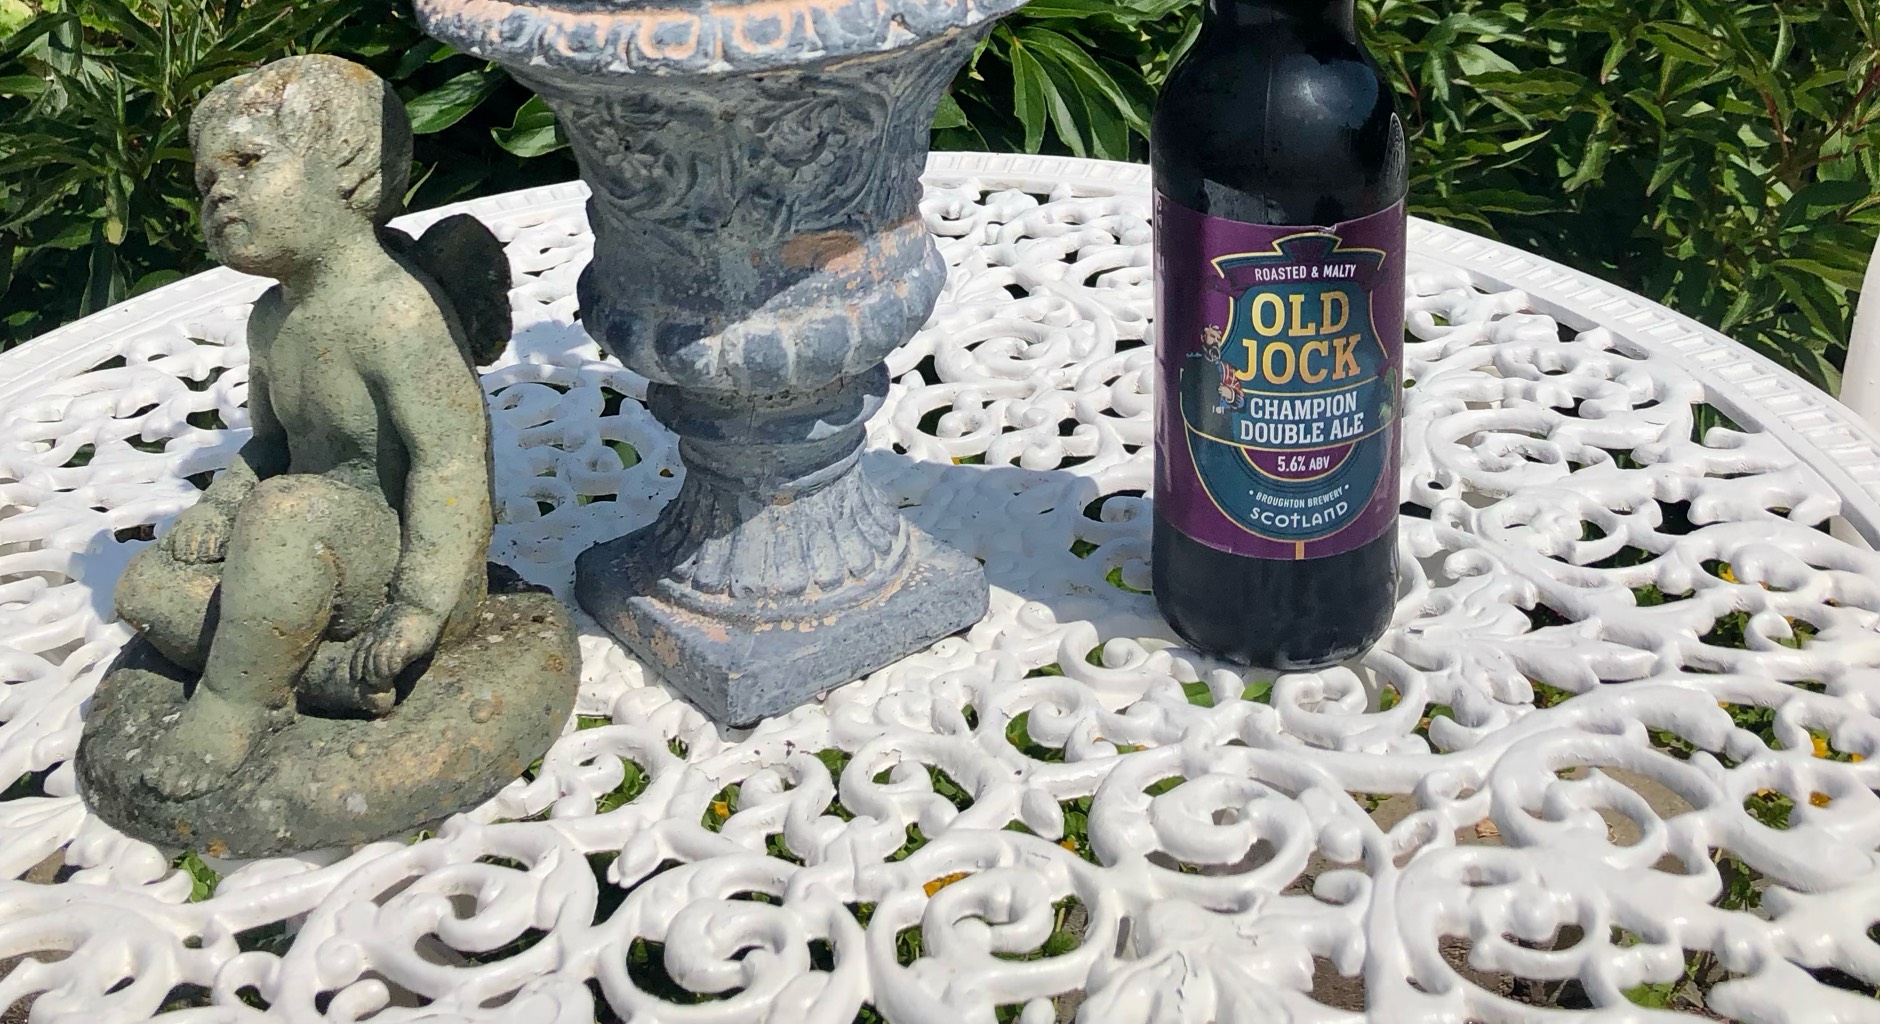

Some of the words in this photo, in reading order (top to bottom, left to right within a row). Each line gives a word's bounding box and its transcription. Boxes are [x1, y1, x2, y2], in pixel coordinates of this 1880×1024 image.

[1254, 265, 1307, 281] ROASTED
[1311, 266, 1319, 278] &
[1323, 264, 1357, 278] MALTY
[1251, 291, 1350, 337] OLD
[1234, 333, 1361, 385] JOCK
[1250, 390, 1358, 421] CHAMPION
[1240, 419, 1325, 444] DOUBLE
[1329, 411, 1364, 441] ALE
[1277, 455, 1306, 472] 5.6%
[1308, 455, 1330, 471] ABV
[1255, 491, 1305, 509] BROUGHTON
[1307, 486, 1343, 508] BREWERY
[1249, 501, 1349, 529] SCOTLAND
